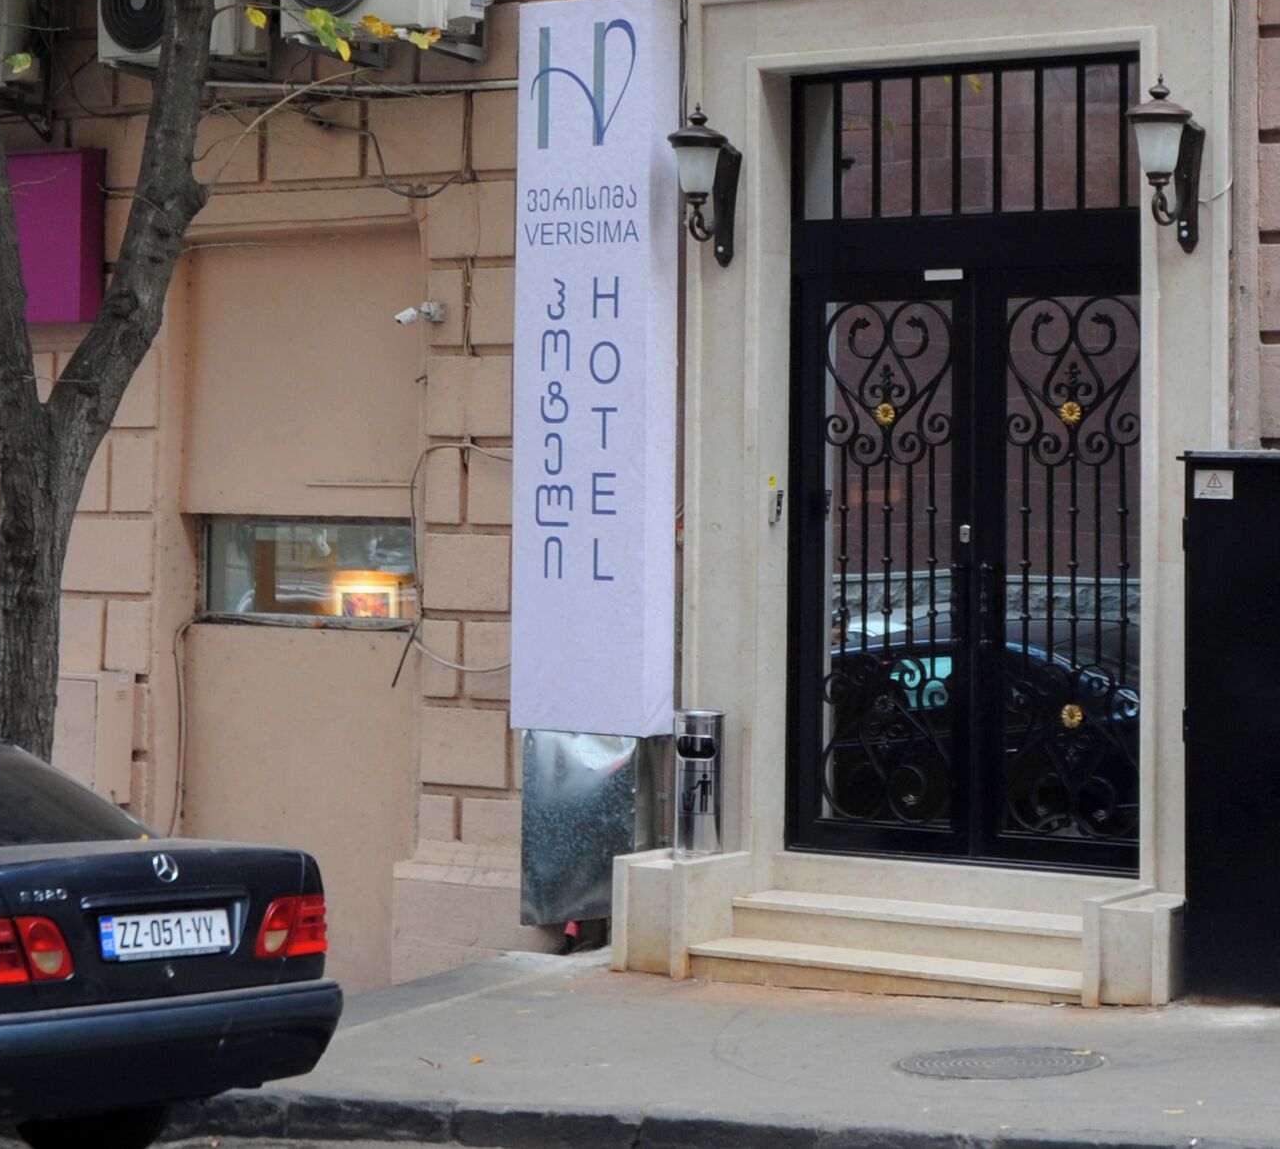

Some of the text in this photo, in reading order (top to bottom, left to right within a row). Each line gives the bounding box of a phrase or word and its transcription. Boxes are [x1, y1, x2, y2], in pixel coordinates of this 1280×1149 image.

[527, 185, 637, 213] ვერისიმა
[524, 219, 640, 247] VERISIMA
[589, 275, 621, 581] HOTEL
[117, 916, 213, 949] ZZ-051-YY
